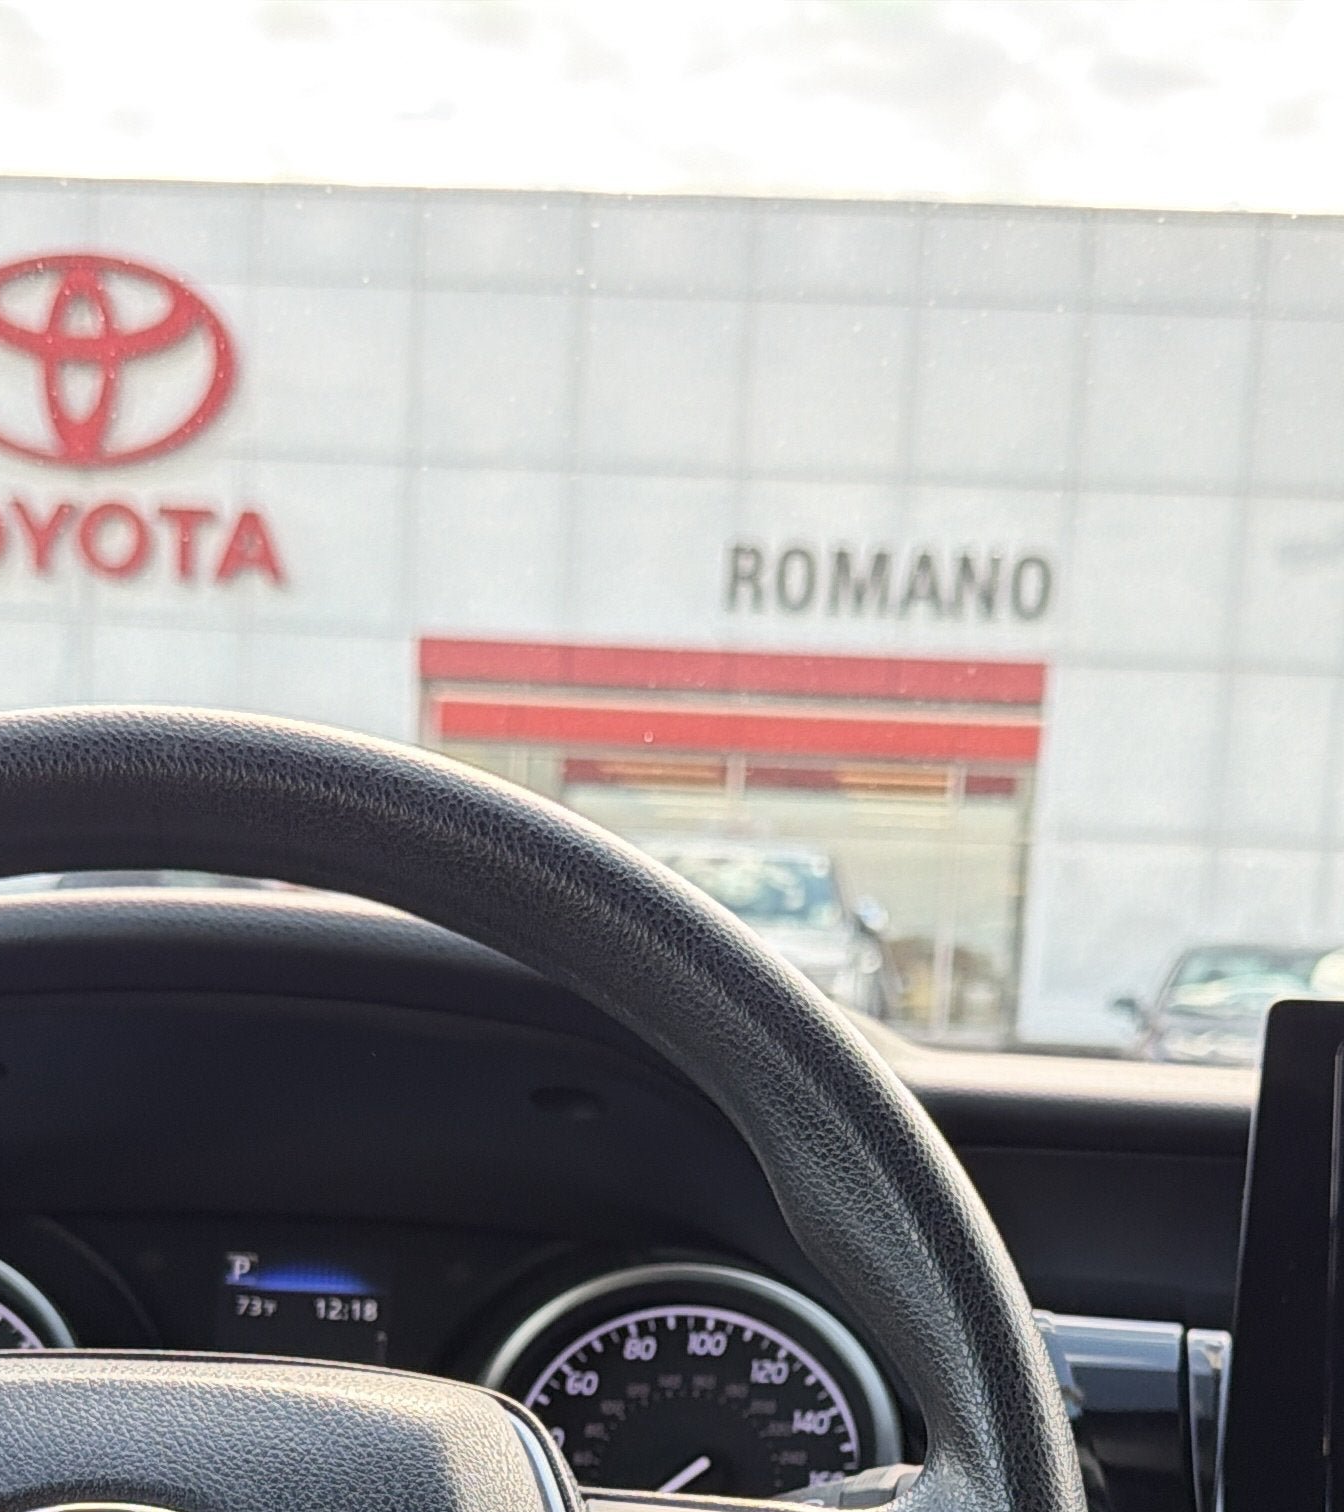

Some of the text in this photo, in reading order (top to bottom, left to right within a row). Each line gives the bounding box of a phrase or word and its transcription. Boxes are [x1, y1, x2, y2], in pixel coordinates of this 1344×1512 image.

[725, 546, 1052, 621] ROMANO
[315, 1297, 378, 1322] 12:18
[623, 1336, 657, 1361] 80
[687, 1331, 728, 1356] 100
[564, 1370, 599, 1397] 60
[750, 1358, 789, 1385] 120
[792, 1409, 832, 1435] 140
